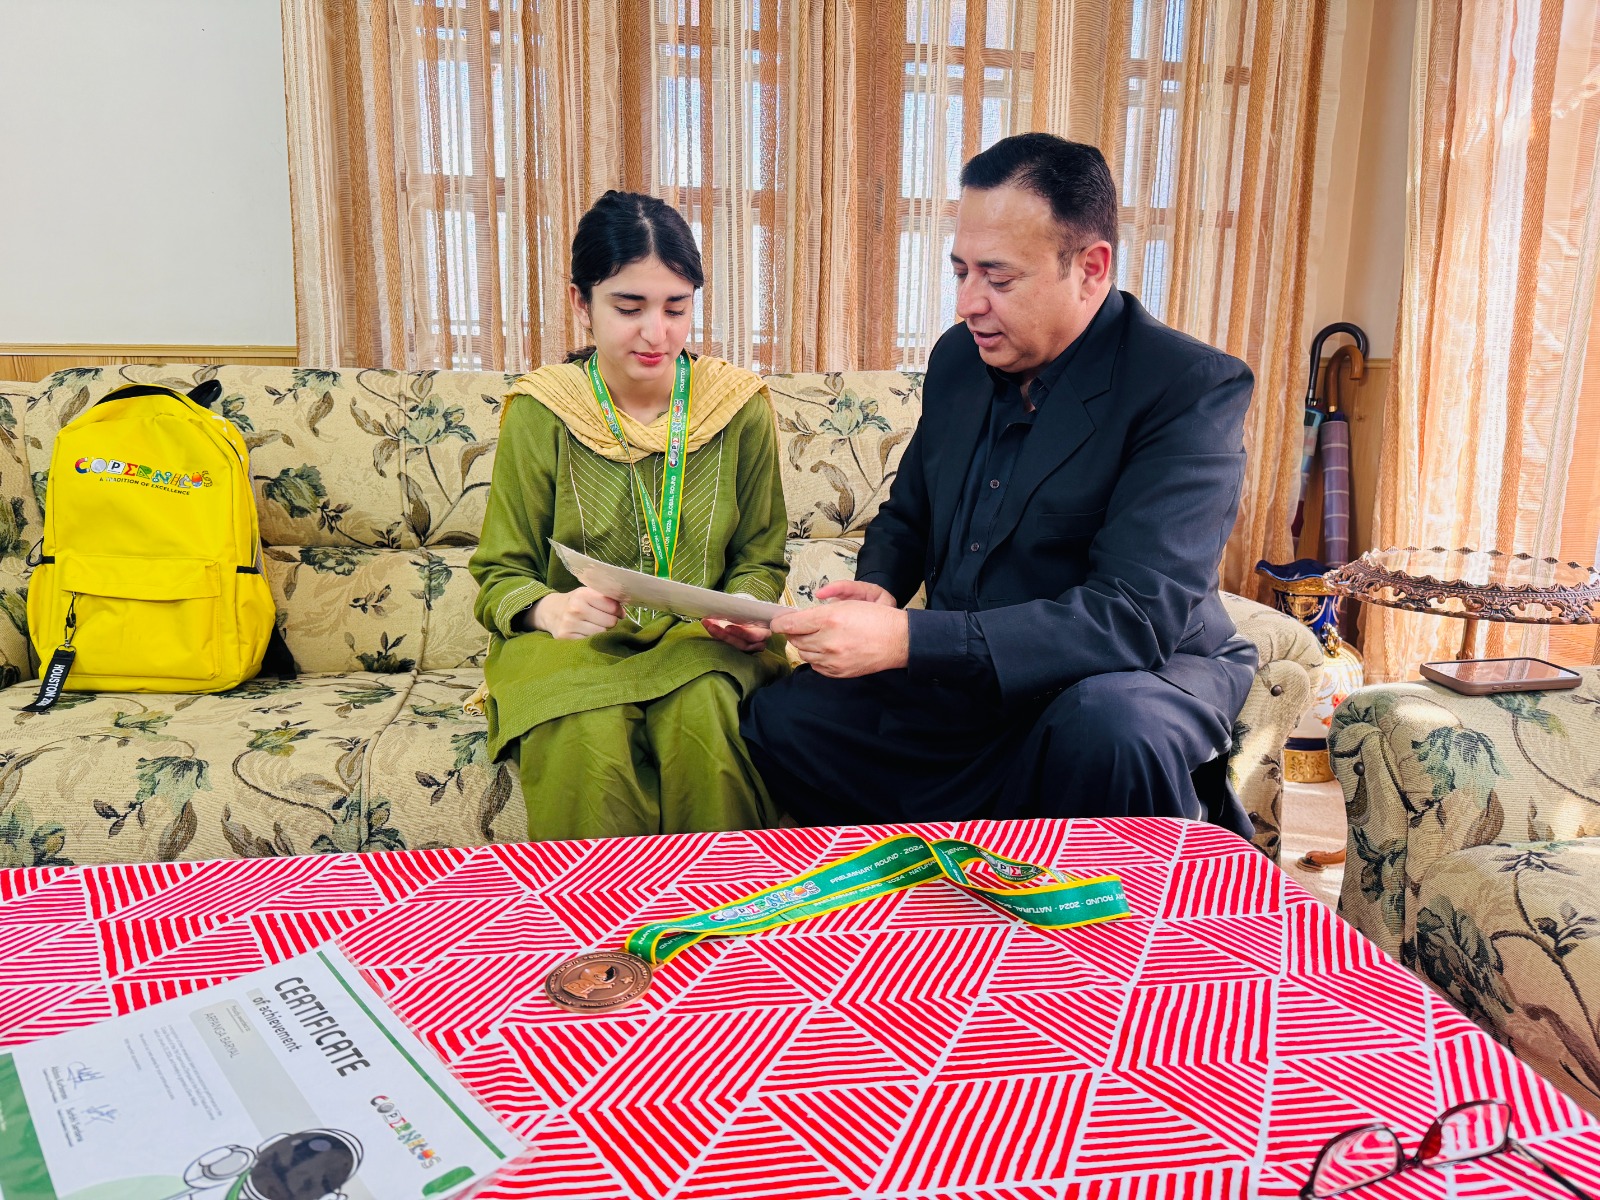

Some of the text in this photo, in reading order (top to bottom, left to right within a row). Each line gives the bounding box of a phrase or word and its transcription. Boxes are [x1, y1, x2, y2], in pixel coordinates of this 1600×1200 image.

[75, 457, 213, 488] COPERNICUS
[151, 484, 190, 495] EXCELLENCE
[44, 664, 66, 697] HOUSTON
[830, 865, 873, 884] PRELIMINARY
[874, 852, 898, 868] ROUND
[903, 845, 924, 854] 2024
[709, 881, 821, 921] COPERNICUS
[1059, 901, 1080, 910] 2024
[1086, 896, 1114, 905] ROUND
[253, 997, 302, 1052] of achievement
[275, 977, 370, 1076] CERTIFICATE
[370, 1095, 442, 1169] COPERNICUS
